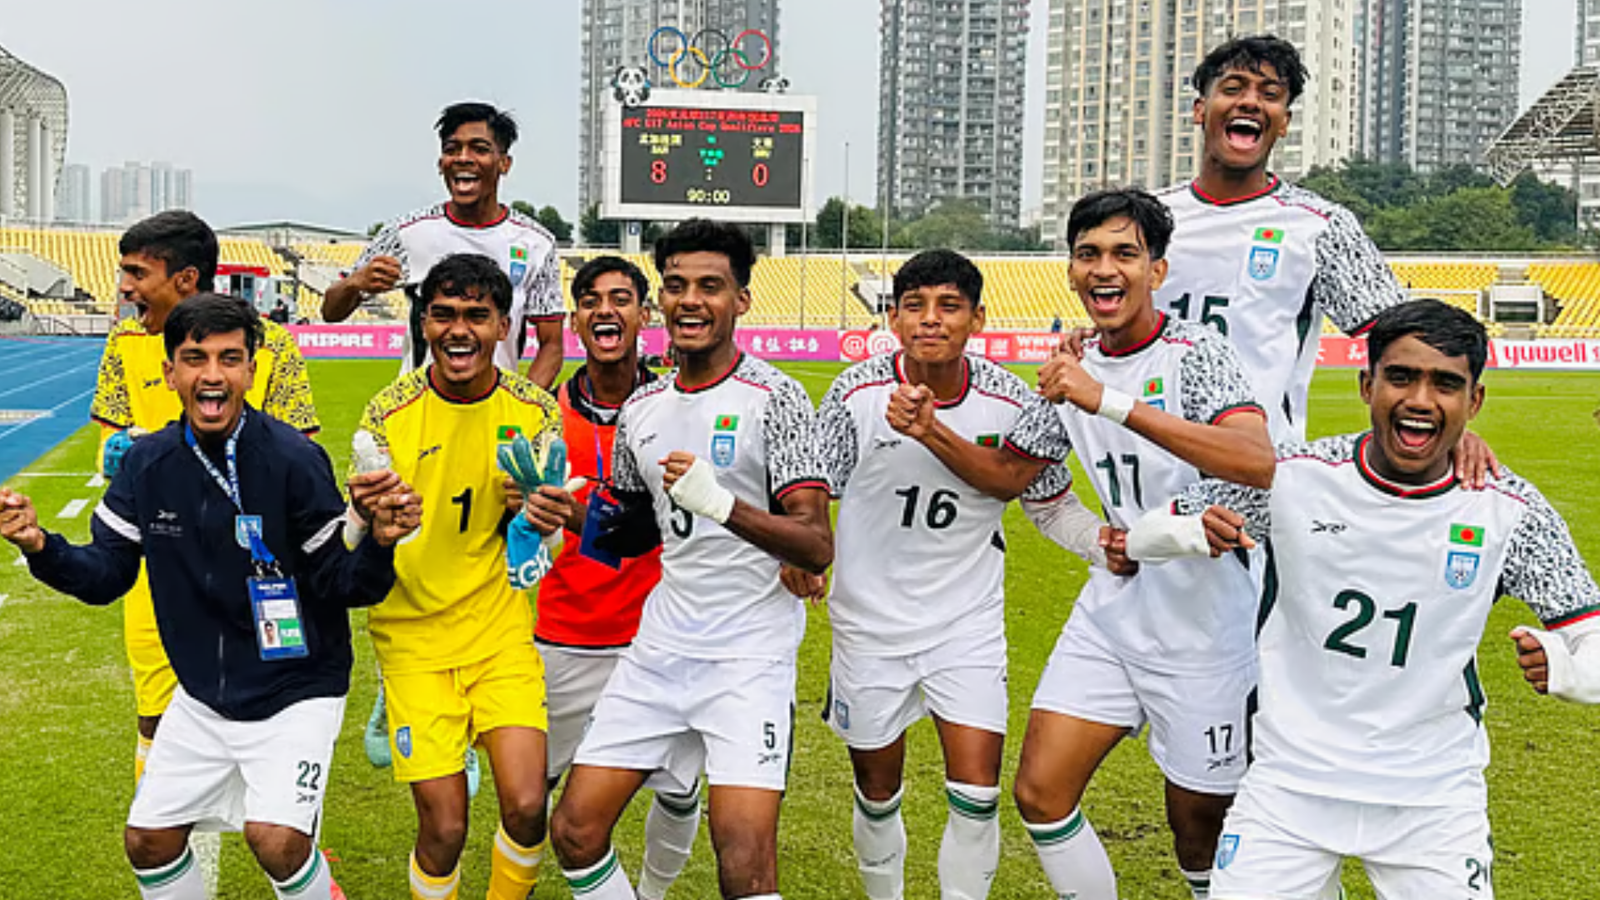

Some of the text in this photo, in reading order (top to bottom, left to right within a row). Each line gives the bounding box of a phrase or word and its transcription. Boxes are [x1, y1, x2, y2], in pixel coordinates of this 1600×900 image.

[651, 158, 667, 184] 8
[752, 162, 769, 187] 0
[686, 188, 731, 204] 90:00
[1169, 292, 1229, 337] 15
[1503, 342, 1586, 367] yuwell
[1096, 451, 1144, 510] 17
[451, 486, 472, 534] 1
[895, 485, 960, 529] 16
[1323, 588, 1417, 668] 21
[763, 721, 775, 750] 5
[1204, 723, 1232, 754] 17
[296, 760, 321, 790] 22
